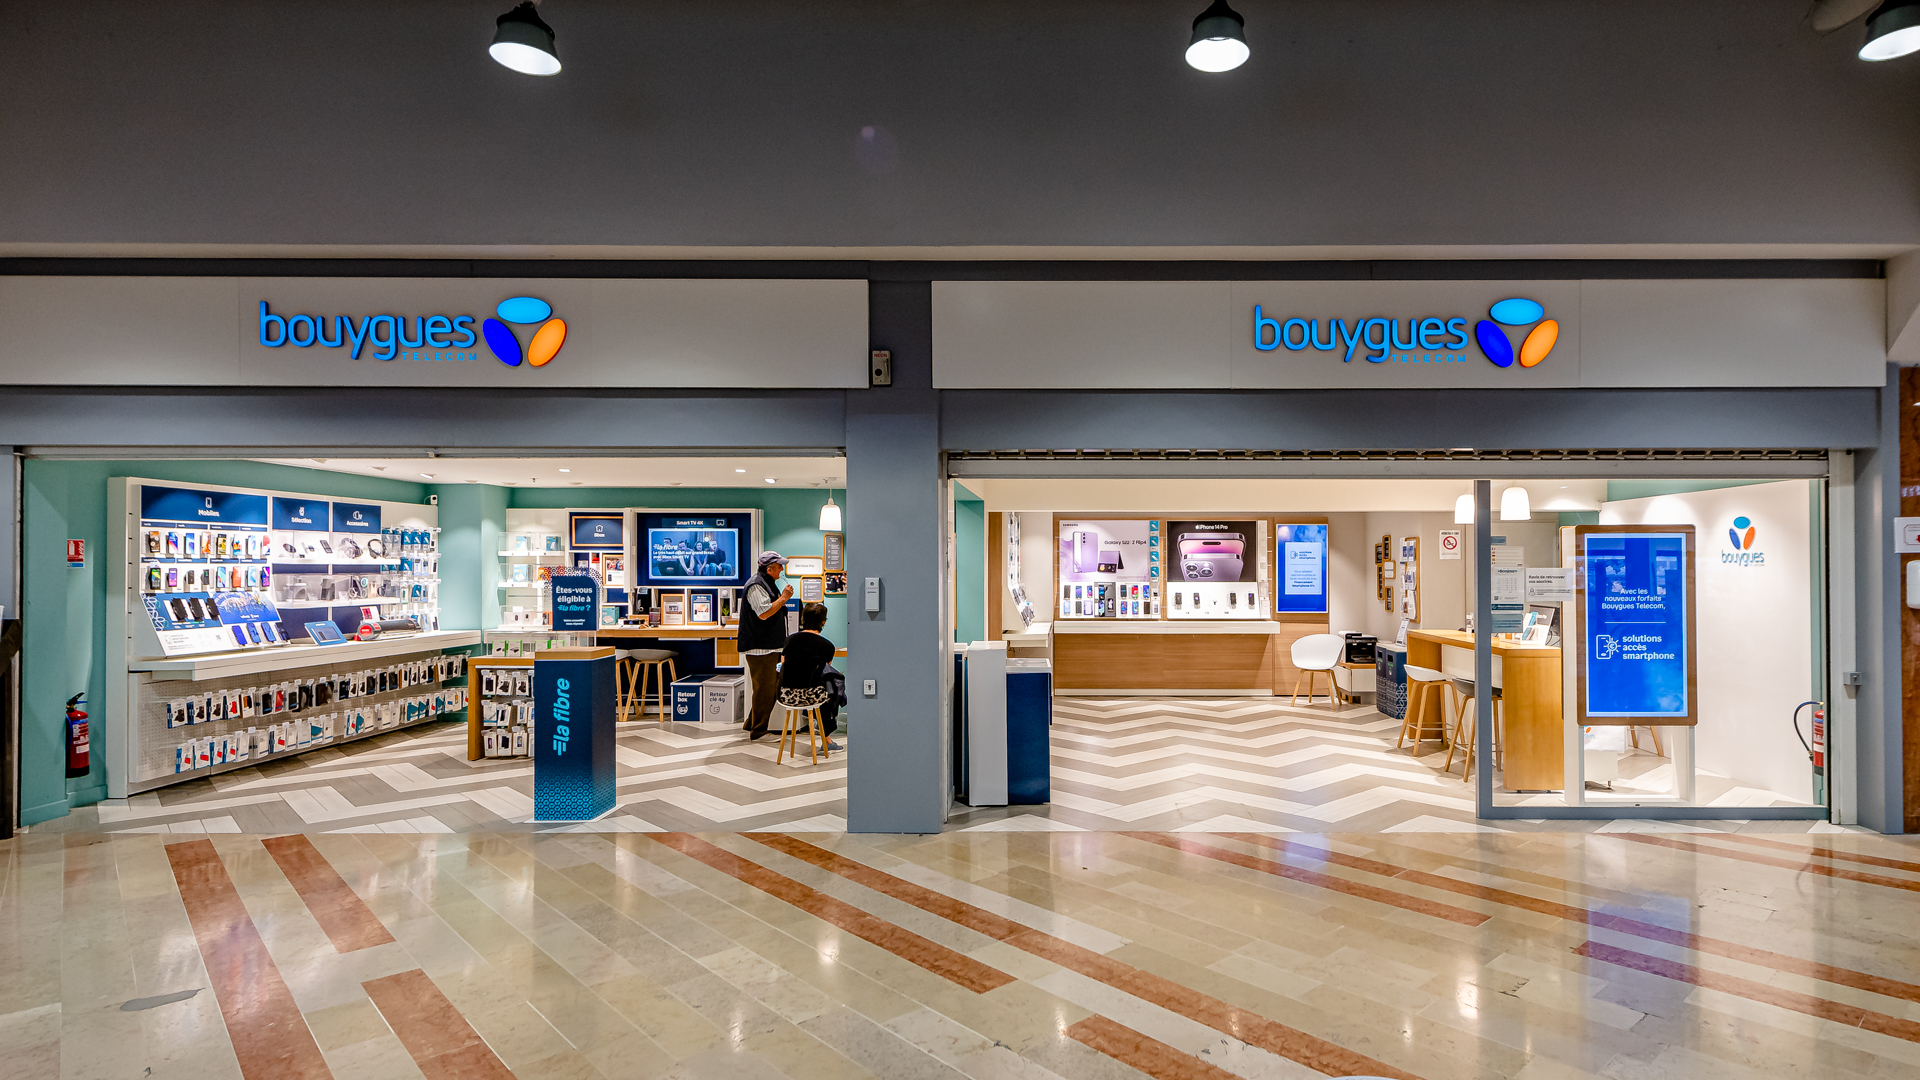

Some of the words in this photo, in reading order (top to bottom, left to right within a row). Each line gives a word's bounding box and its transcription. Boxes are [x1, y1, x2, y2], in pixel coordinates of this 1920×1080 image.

[260, 300, 477, 361] bouygues
[1254, 304, 1468, 363] bouygues
[402, 352, 477, 361] TELECOM
[1392, 354, 1466, 362] TELECOM
[1722, 549, 1764, 567] bouygues
[556, 586, 593, 594] Êtes-vous
[557, 595, 585, 604] éligible
[1622, 652, 1675, 661] smartphone
[553, 678, 570, 722] fibre
[553, 725, 570, 742] la
